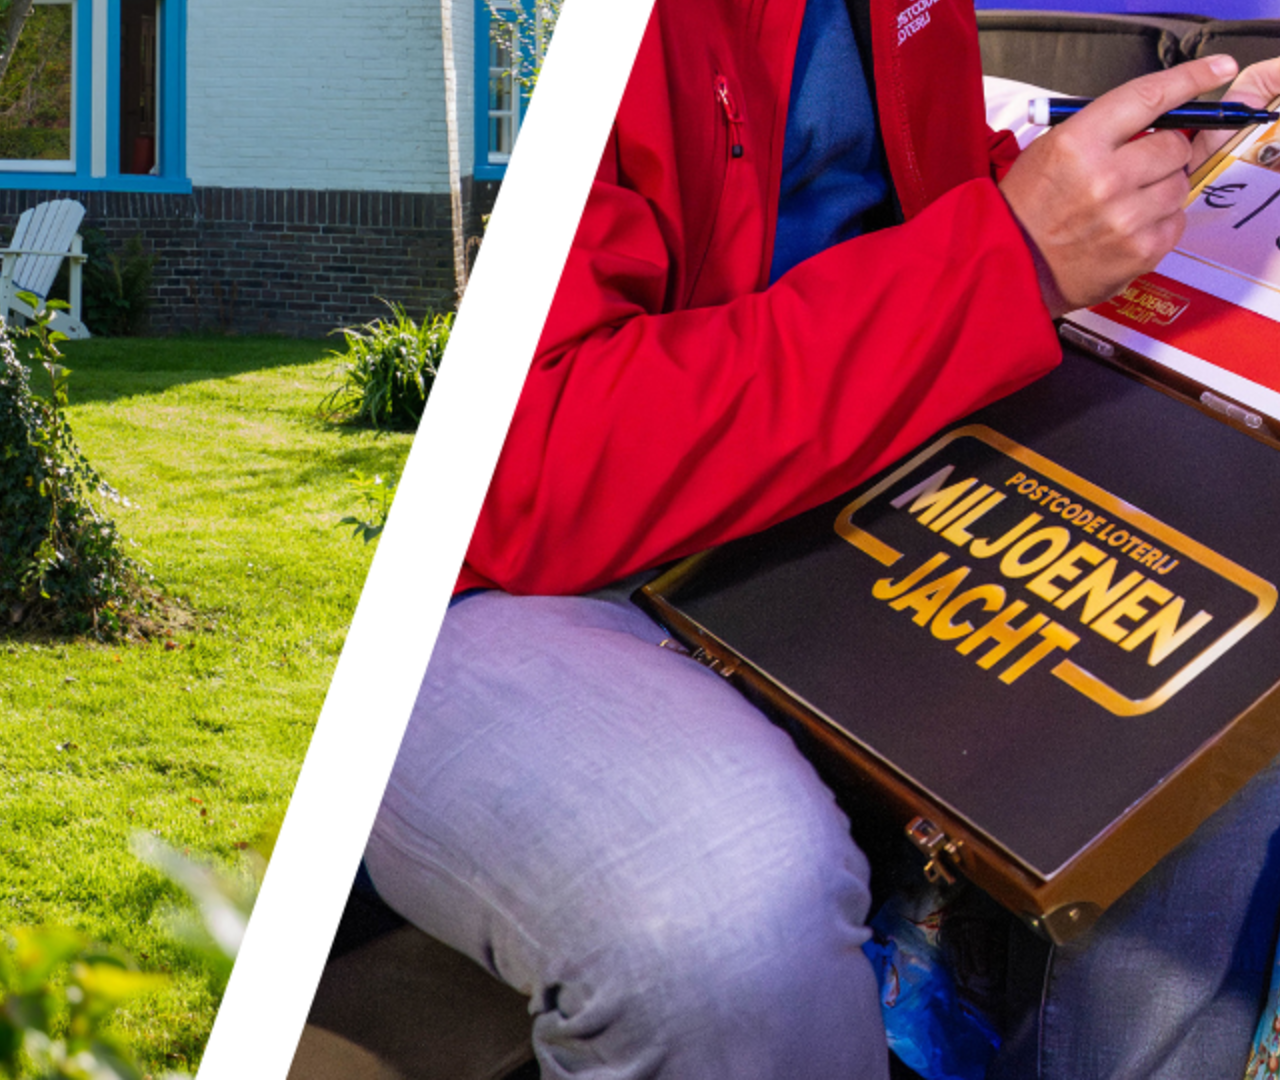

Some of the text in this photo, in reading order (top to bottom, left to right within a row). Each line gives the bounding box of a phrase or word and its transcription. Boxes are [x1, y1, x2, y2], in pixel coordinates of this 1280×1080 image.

[889, 464, 1214, 667] MILJOENEN
[1005, 471, 1180, 575] POSTCODE LOTERIJ
[871, 551, 1081, 685] JACHT
